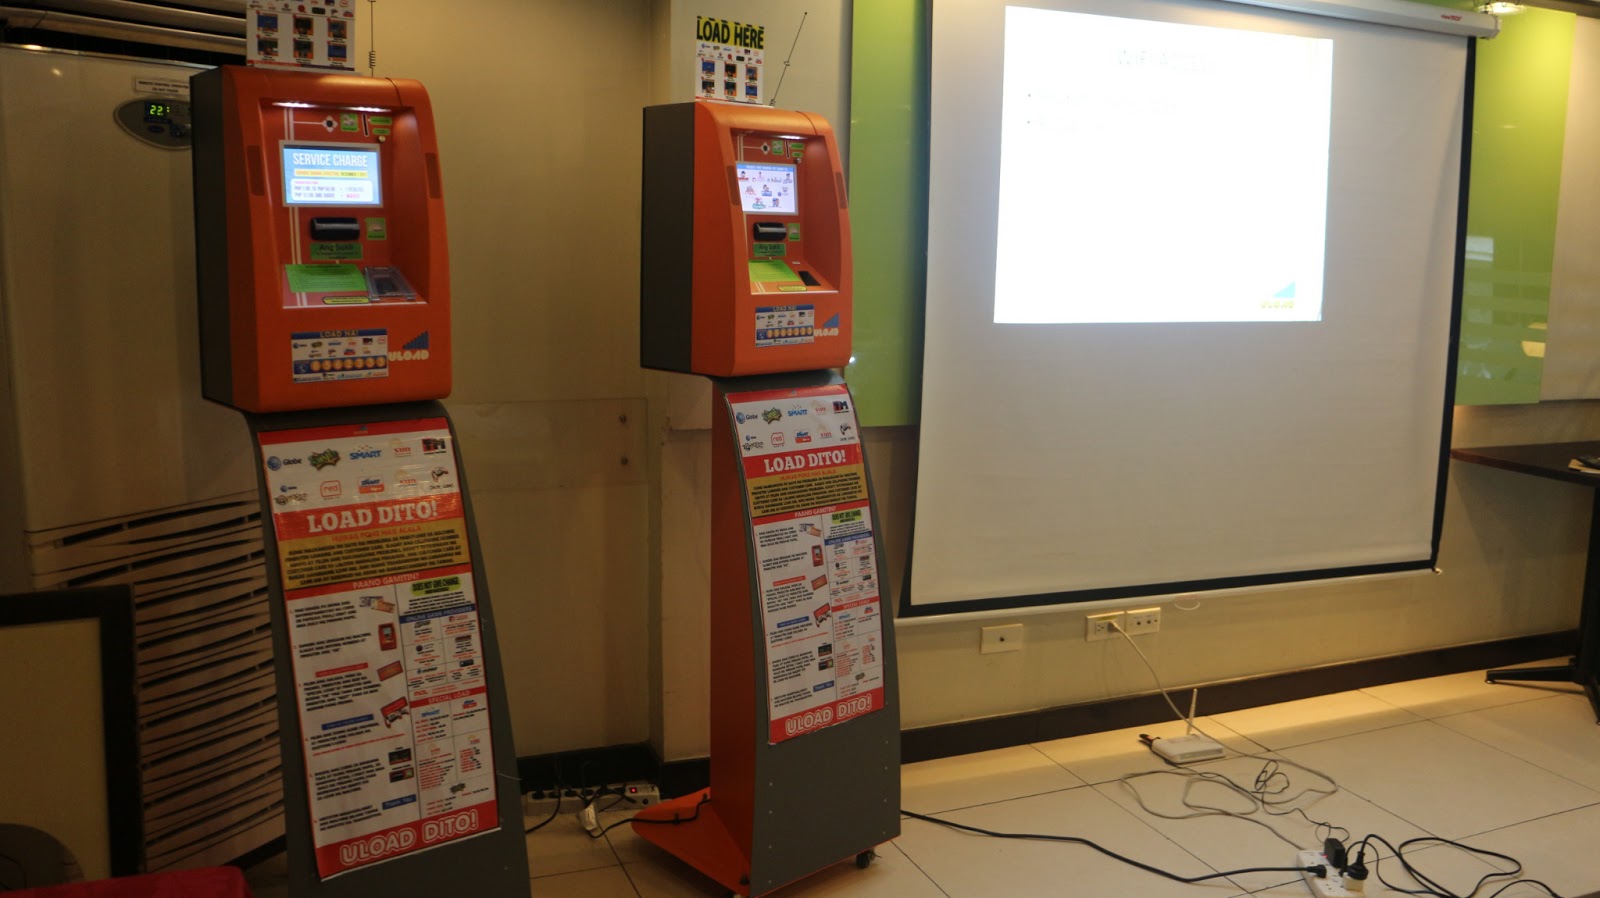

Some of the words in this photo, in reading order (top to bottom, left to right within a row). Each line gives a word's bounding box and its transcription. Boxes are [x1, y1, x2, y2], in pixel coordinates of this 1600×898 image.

[697, 19, 730, 44] LOAD
[734, 26, 764, 49] HERE
[293, 153, 330, 166] SERVICE
[333, 155, 368, 167] CHARGE
[814, 328, 839, 337] ULOAD
[388, 350, 429, 361] ULOAD
[283, 457, 302, 465] Globe
[350, 450, 382, 460] SMART
[764, 454, 805, 473] LOAD
[808, 450, 846, 468] DITO!
[307, 507, 373, 533] LOAD
[377, 500, 438, 524] DITO!
[352, 580, 380, 589] PAANO
[382, 573, 419, 585] GAMITIN?
[428, 695, 452, 703] SPECIAL
[454, 691, 470, 699] LOAD
[786, 707, 833, 736] ULOAD
[837, 694, 872, 719] DITO!
[340, 828, 416, 865] ULOAD
[423, 809, 478, 843] DITO!
